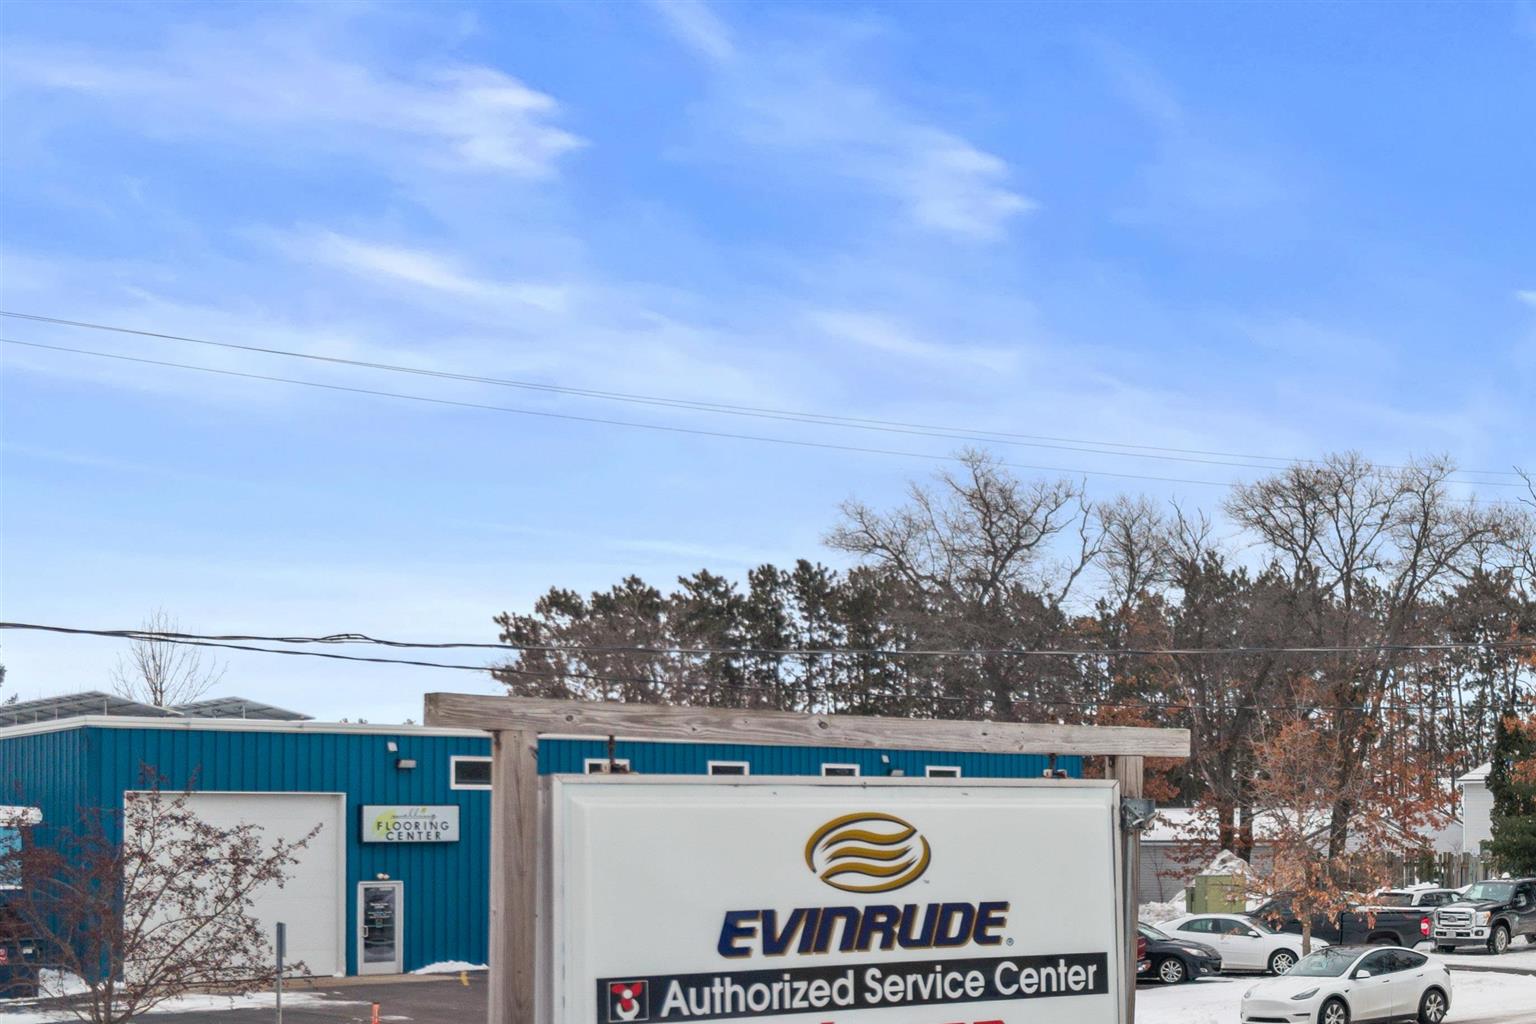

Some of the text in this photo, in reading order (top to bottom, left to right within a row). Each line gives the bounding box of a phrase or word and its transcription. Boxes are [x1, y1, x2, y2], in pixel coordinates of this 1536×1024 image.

[376, 821, 449, 831] FLOORING
[385, 831, 441, 841] CENTER
[717, 901, 1009, 960] EVINRUDE
[661, 958, 1097, 1018] Authorized Service Center
